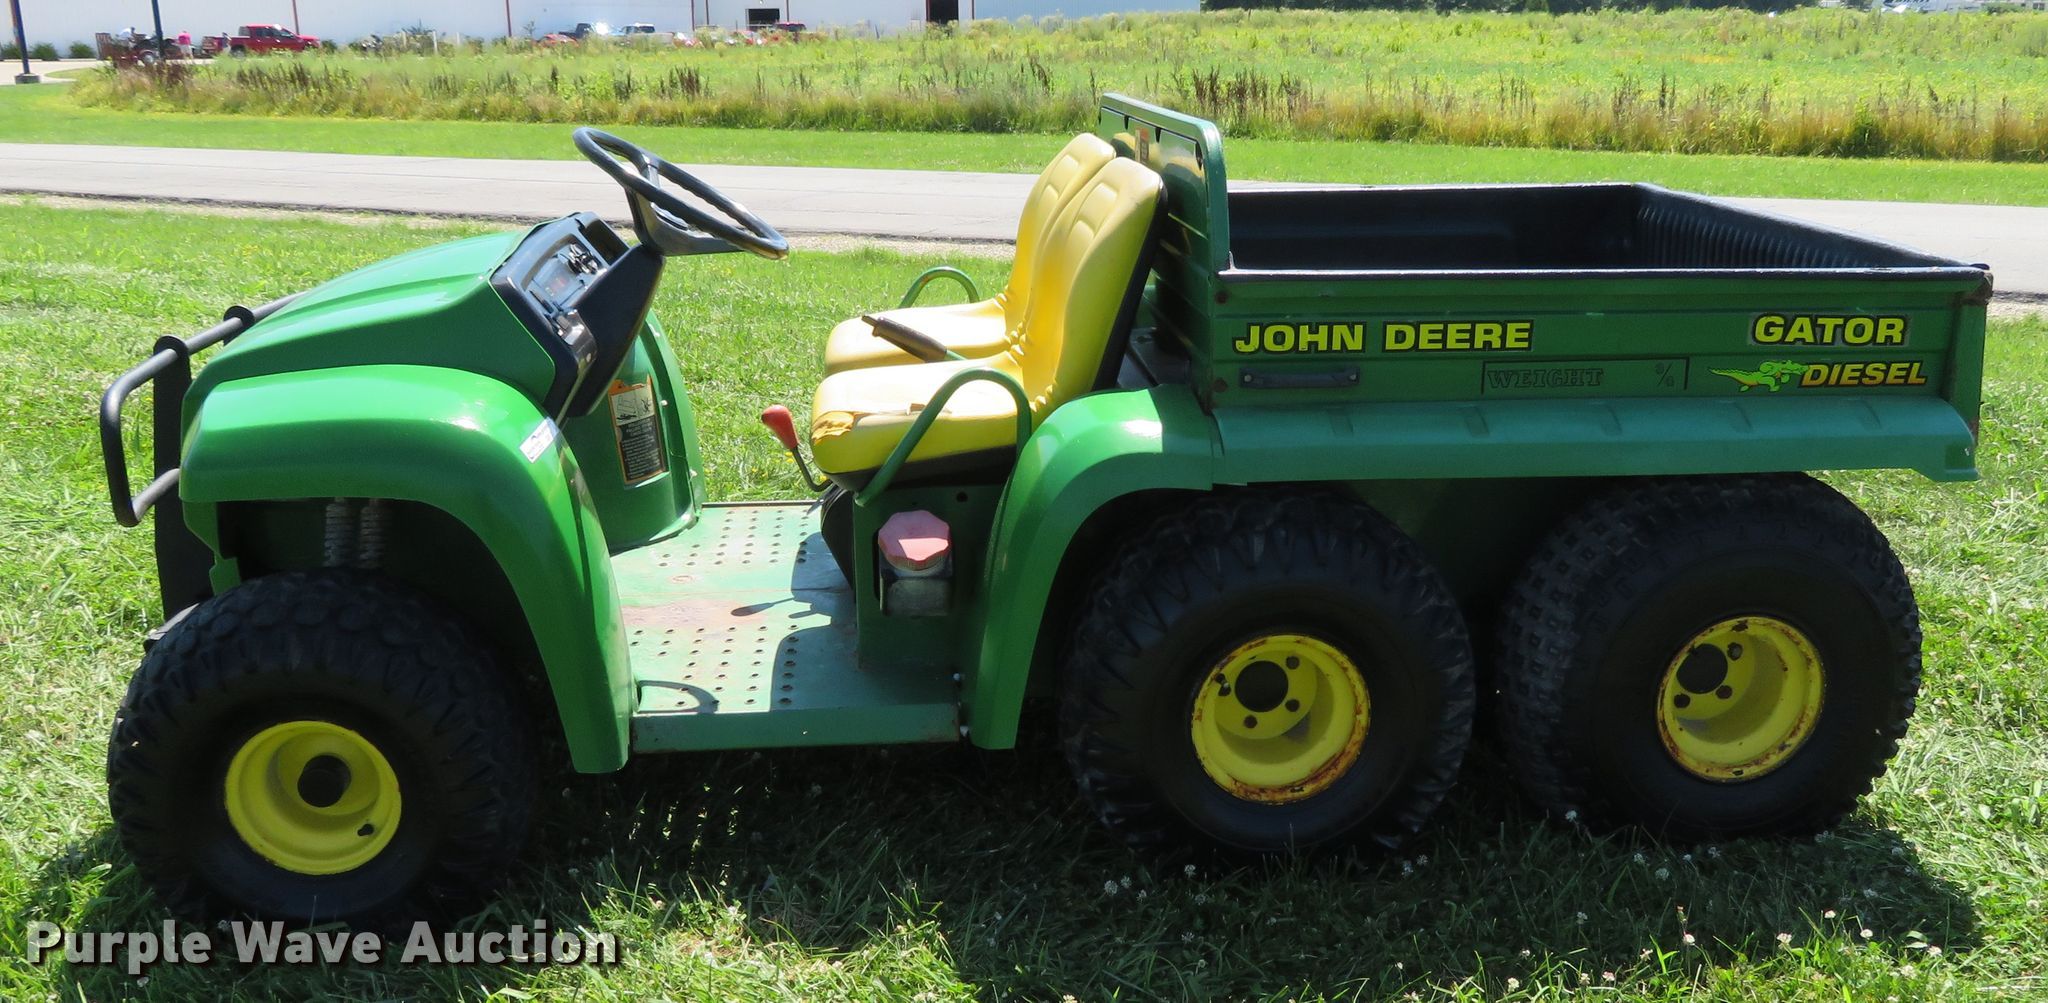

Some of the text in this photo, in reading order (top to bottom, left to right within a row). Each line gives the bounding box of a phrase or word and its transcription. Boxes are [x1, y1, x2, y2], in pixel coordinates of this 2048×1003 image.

[1234, 322, 1532, 353] JOHN DEERE
[1754, 315, 1905, 344] GATOR
[1487, 368, 1604, 388] WEIGHT
[1800, 361, 1927, 387] DIESEL
